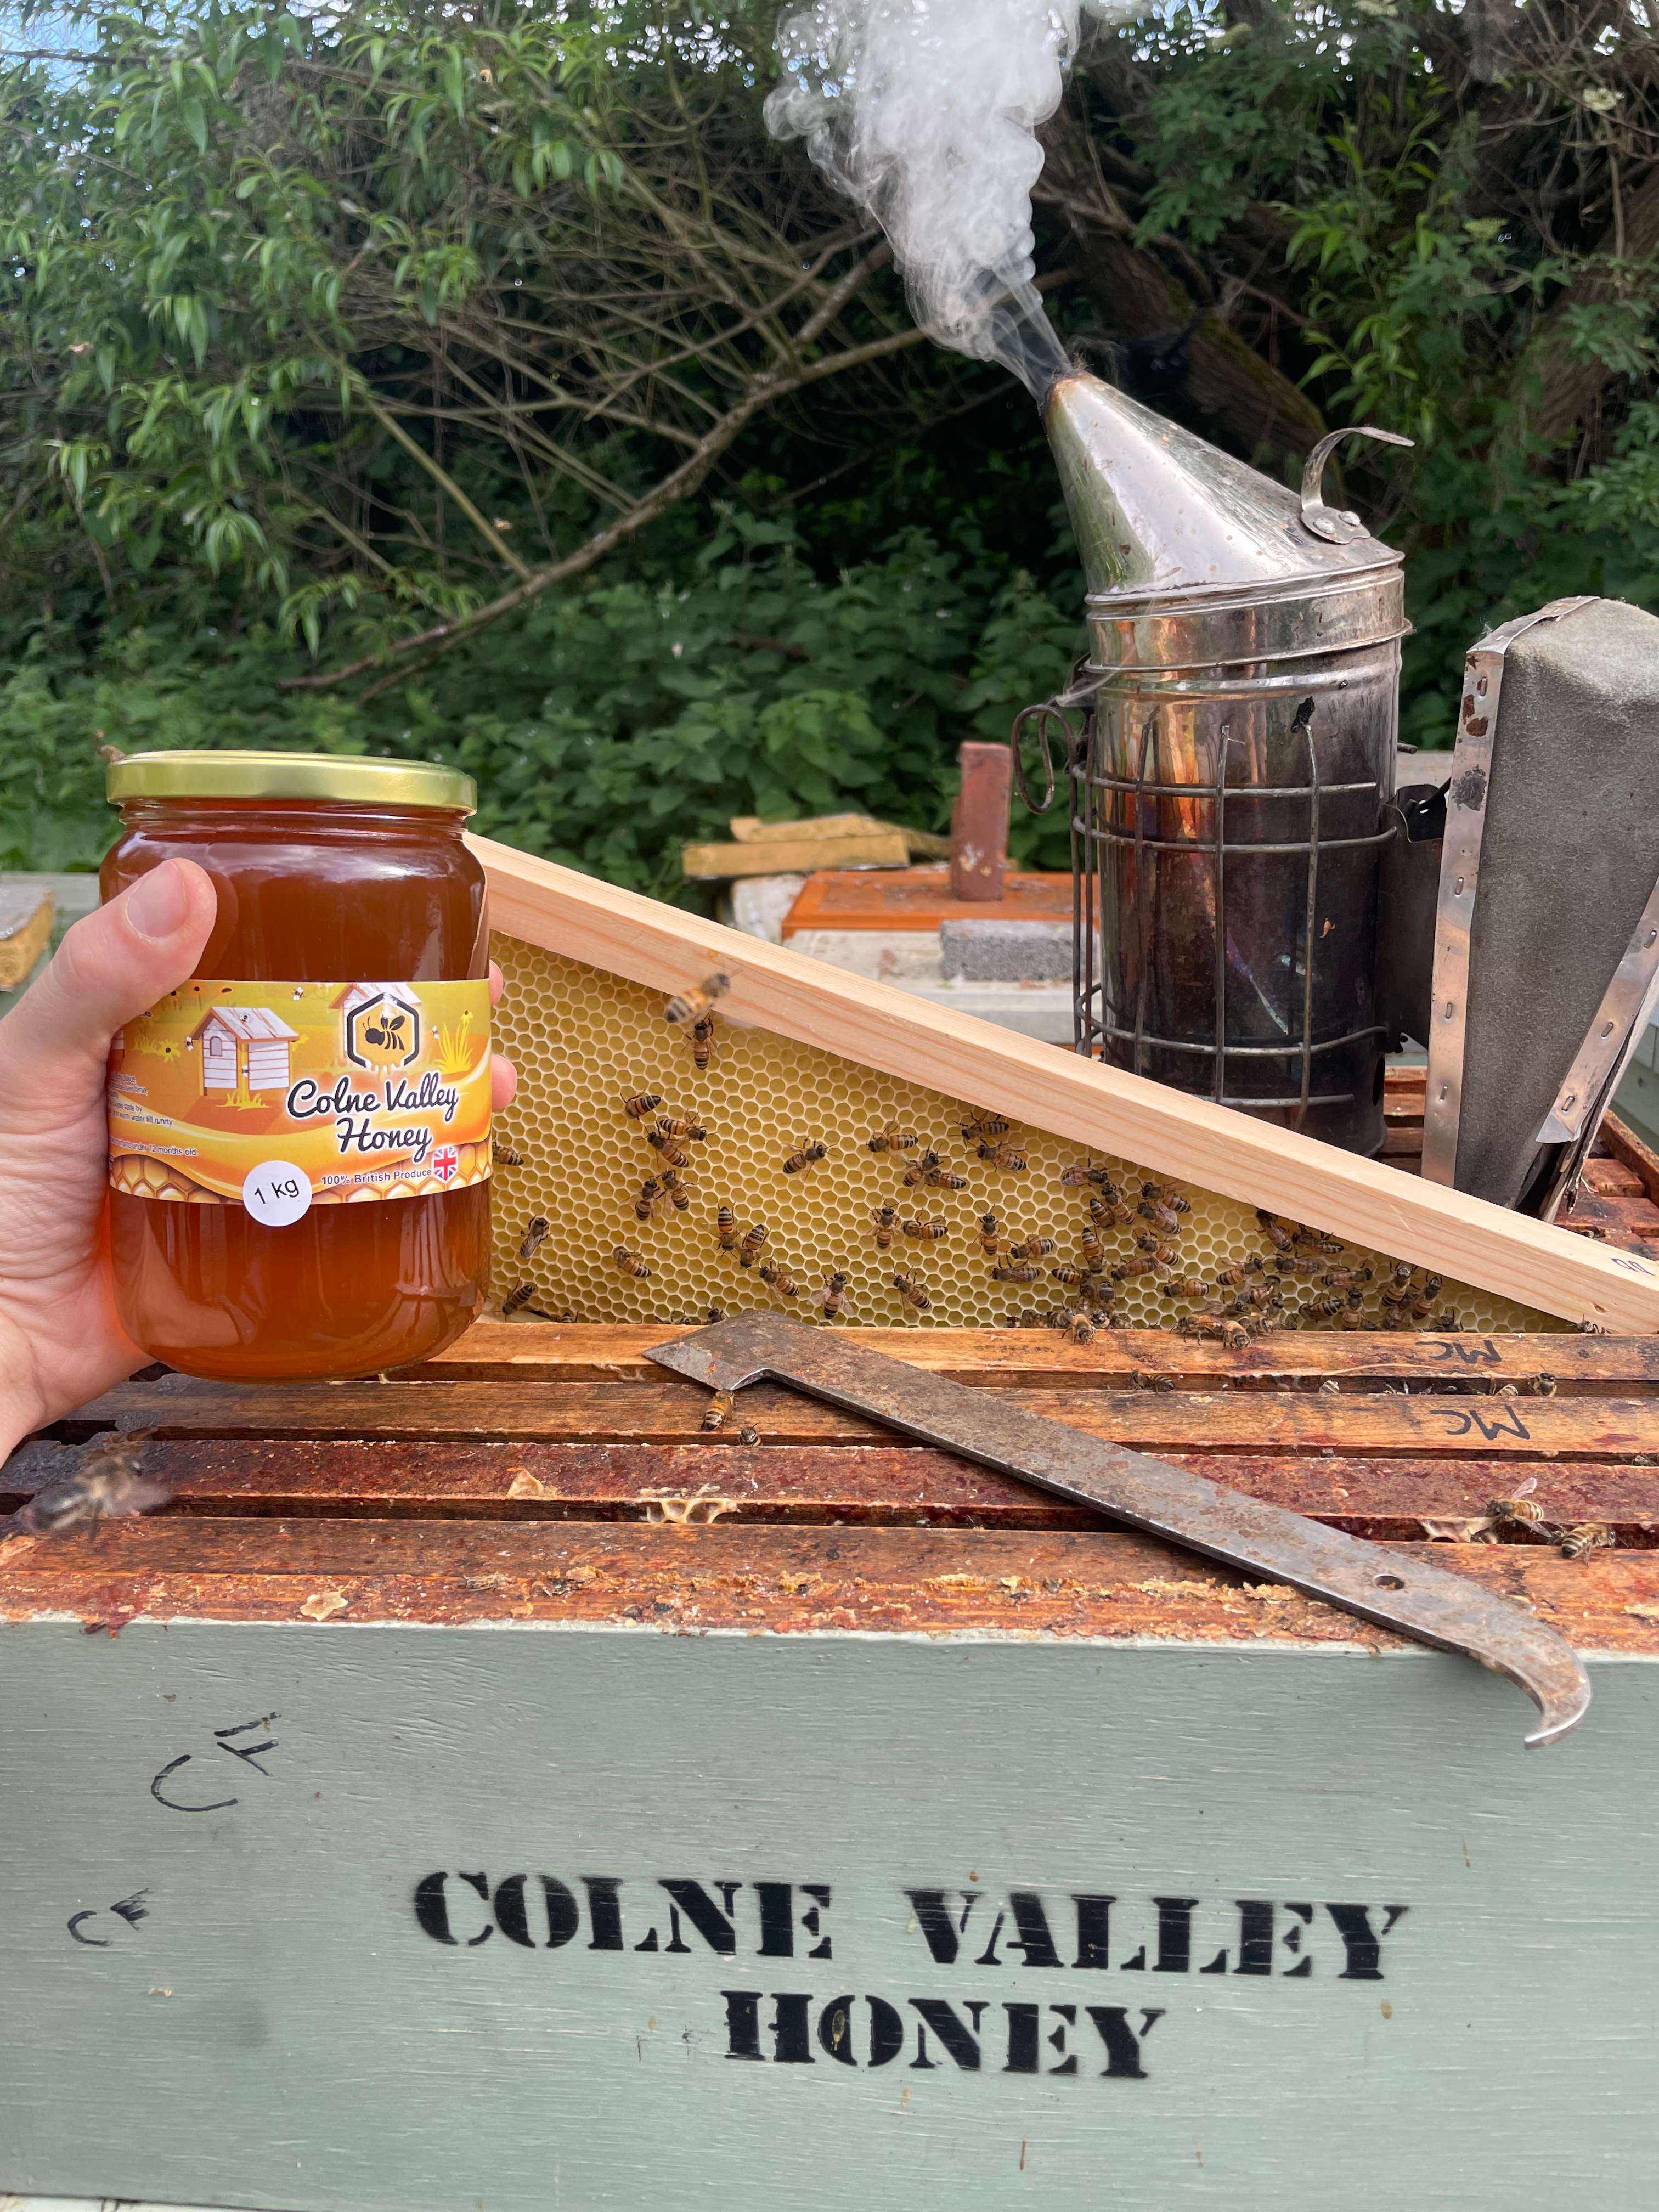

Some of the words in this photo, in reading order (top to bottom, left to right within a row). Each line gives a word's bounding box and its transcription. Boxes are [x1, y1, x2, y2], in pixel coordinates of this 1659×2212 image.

[136, 1104, 142, 1114] by
[287, 1076, 381, 1118] Colne
[386, 1072, 459, 1122] Valley
[154, 1118, 173, 1127] runny
[132, 1143, 147, 1151] under
[149, 1144, 156, 1153] 12
[158, 1147, 183, 1155] months
[337, 1117, 432, 1163] Honey
[255, 1187, 266, 1204] 1
[271, 1179, 299, 1199] kg
[321, 1175, 350, 1185] 100%
[354, 1171, 390, 1183] British
[394, 1169, 432, 1180] Produce
[1430, 1404, 1530, 1440] MC
[413, 1871, 832, 1959] COLNE
[904, 1889, 1409, 1980] VALLEY
[720, 1990, 1165, 2079] HONEY
